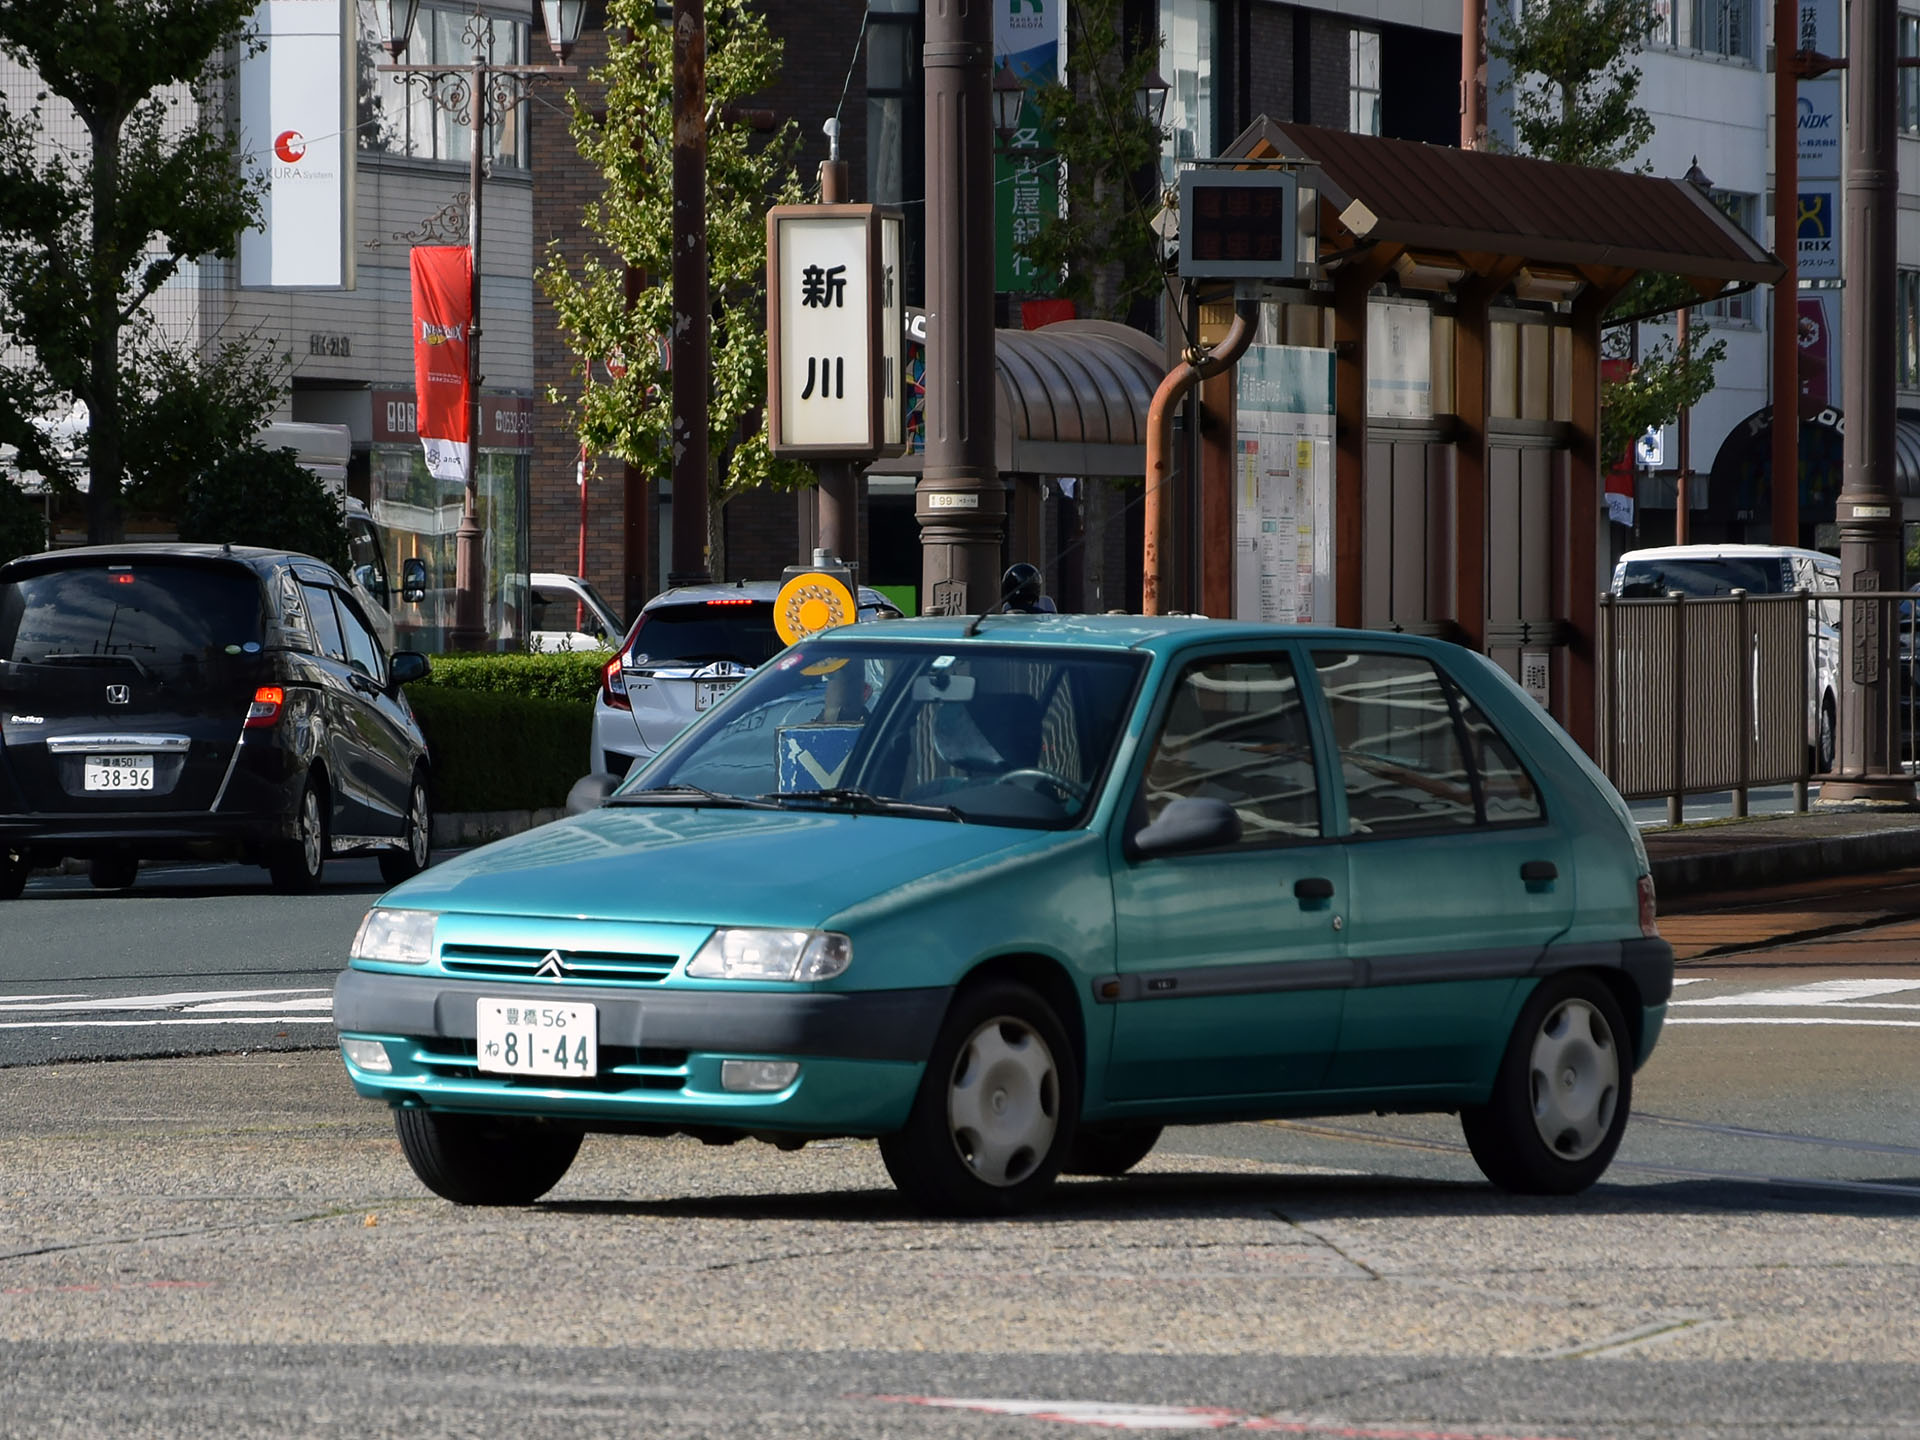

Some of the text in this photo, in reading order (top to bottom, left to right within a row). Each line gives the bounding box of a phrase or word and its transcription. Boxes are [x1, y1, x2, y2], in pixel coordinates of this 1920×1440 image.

[247, 167, 303, 180] SAKURA
[800, 263, 848, 401] 新川
[101, 769, 150, 787] 38-96
[504, 1031, 588, 1071] 81-44
